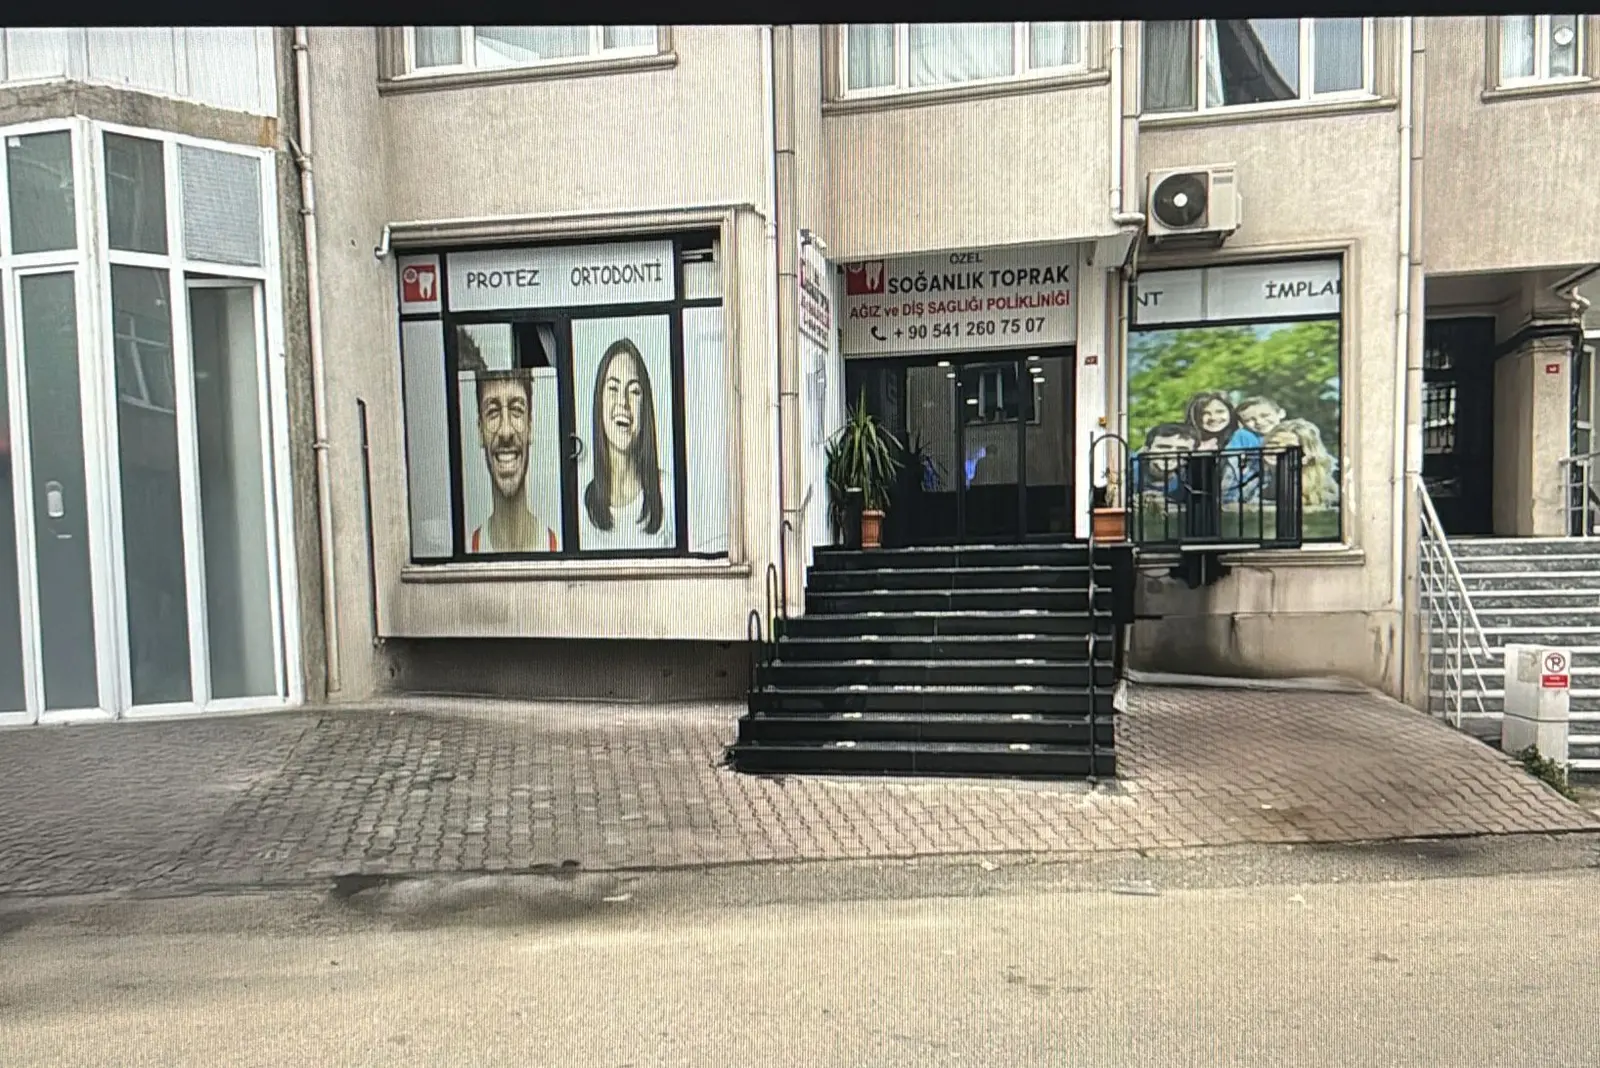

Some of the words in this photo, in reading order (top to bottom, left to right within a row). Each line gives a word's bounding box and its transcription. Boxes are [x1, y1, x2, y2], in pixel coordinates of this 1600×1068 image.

[467, 268, 541, 289] PROTEZ
[571, 258, 662, 286] ORTODONTİ
[888, 270, 984, 294] SOĞANLIK
[989, 265, 1070, 287] TOPRAK
[884, 306, 899, 317] ve
[908, 325, 927, 339] 90
[932, 323, 960, 338] 541
[966, 321, 995, 336] 260
[1001, 318, 1021, 334] 75
[1025, 317, 1046, 332] 07
